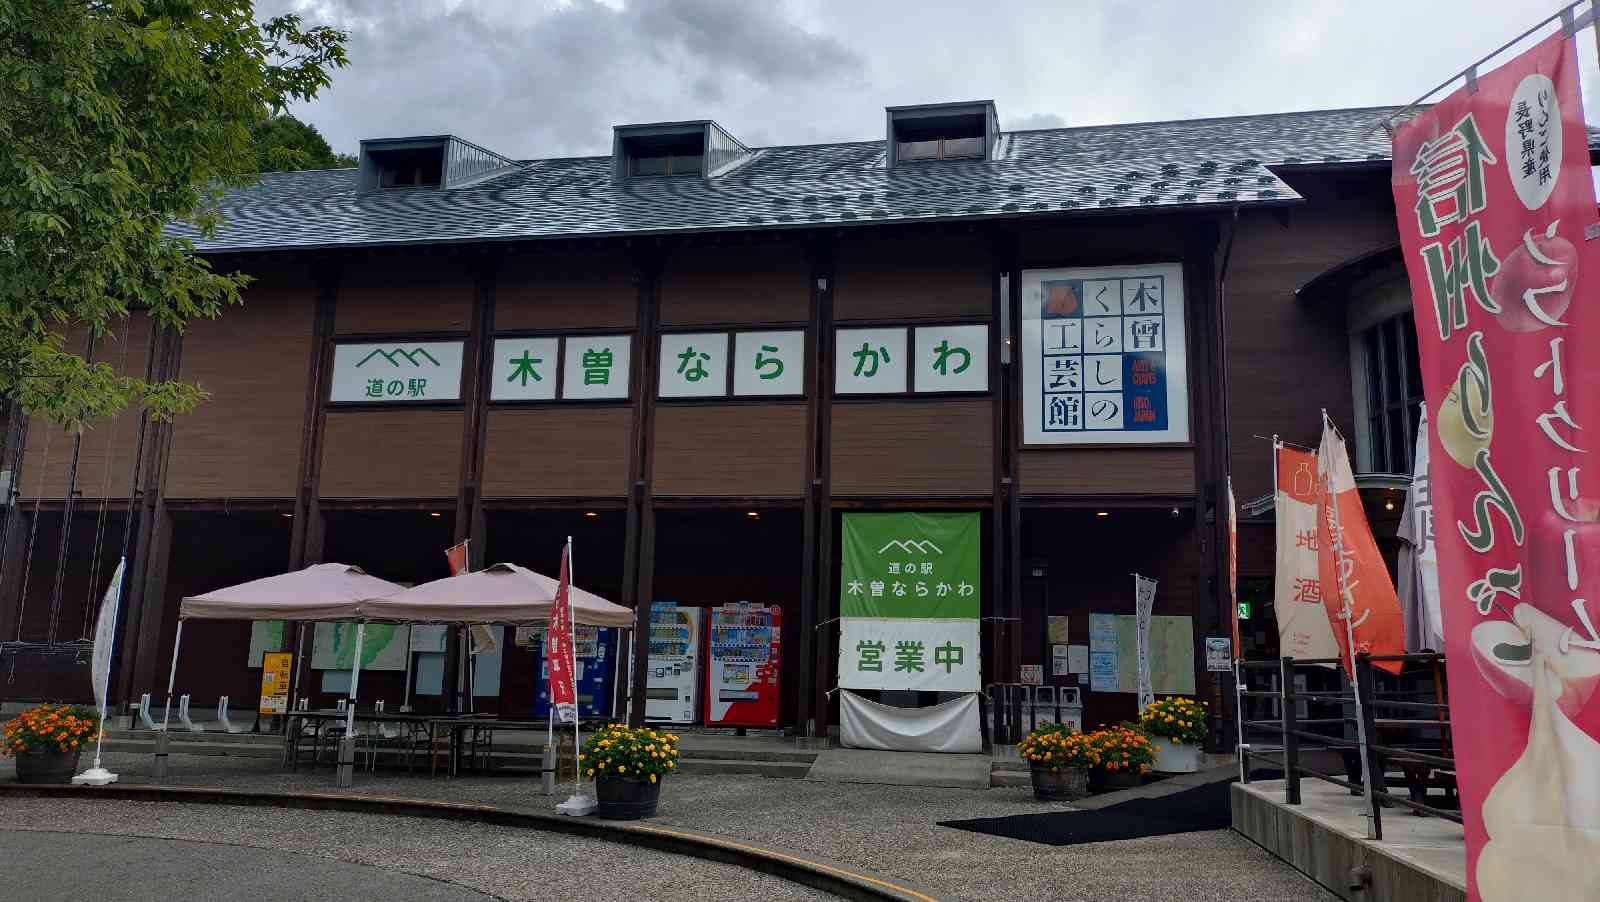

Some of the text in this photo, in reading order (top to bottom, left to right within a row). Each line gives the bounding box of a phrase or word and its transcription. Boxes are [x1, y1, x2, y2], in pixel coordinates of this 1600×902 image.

[1091, 285, 1119, 422] くらしの
[365, 378, 428, 398] 道の駅
[1047, 321, 1080, 427] 工芸館
[887, 561, 934, 576] 道の駅
[1293, 528, 1321, 604] 地酒
[847, 579, 975, 597] 木曽ならかわ
[856, 639, 964, 674] 営業中
